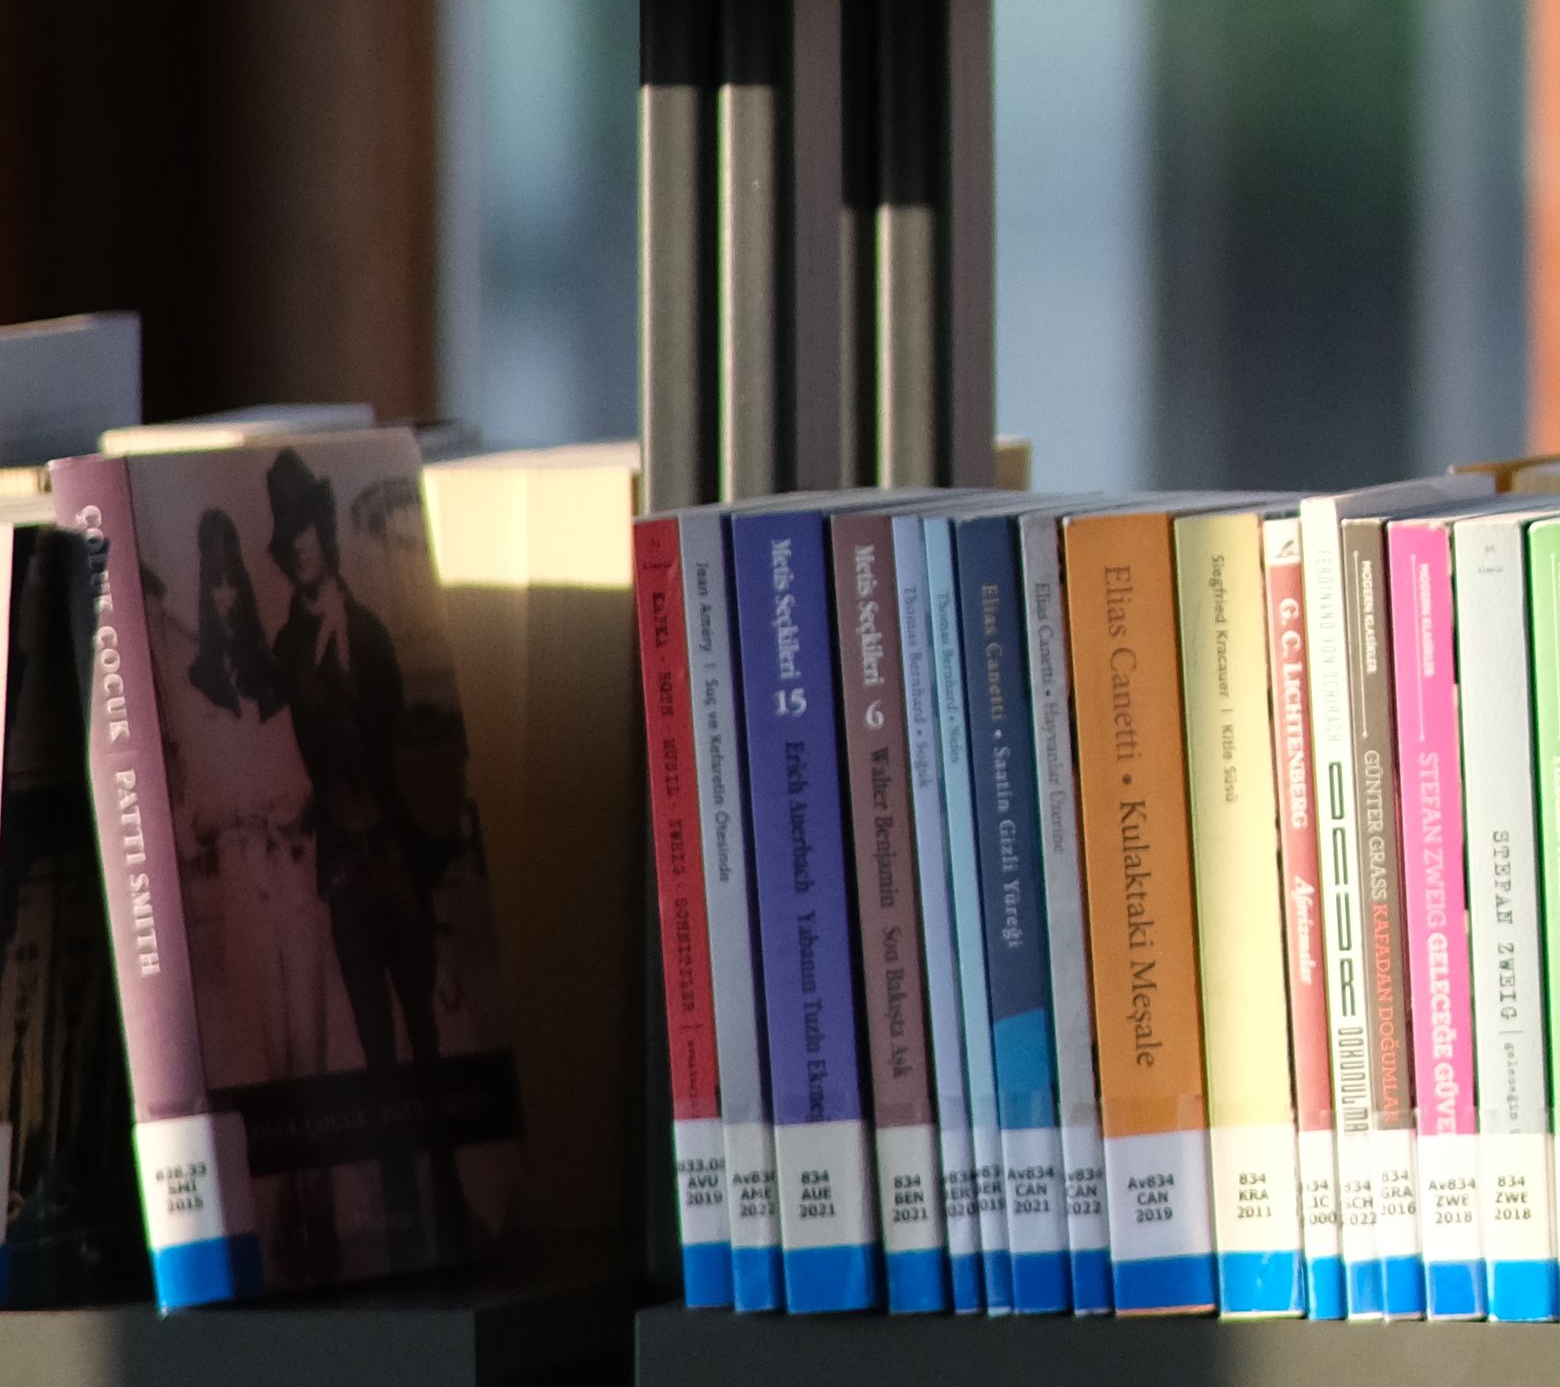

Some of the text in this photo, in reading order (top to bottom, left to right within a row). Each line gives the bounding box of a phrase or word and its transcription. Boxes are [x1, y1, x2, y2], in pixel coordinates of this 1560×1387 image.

[1102, 564, 1164, 1070] Elias Canetti Kulaktaki Meşale
[1278, 598, 1310, 828] G. C. LICHTENBERG
[113, 769, 162, 976] PATTI SMITH
